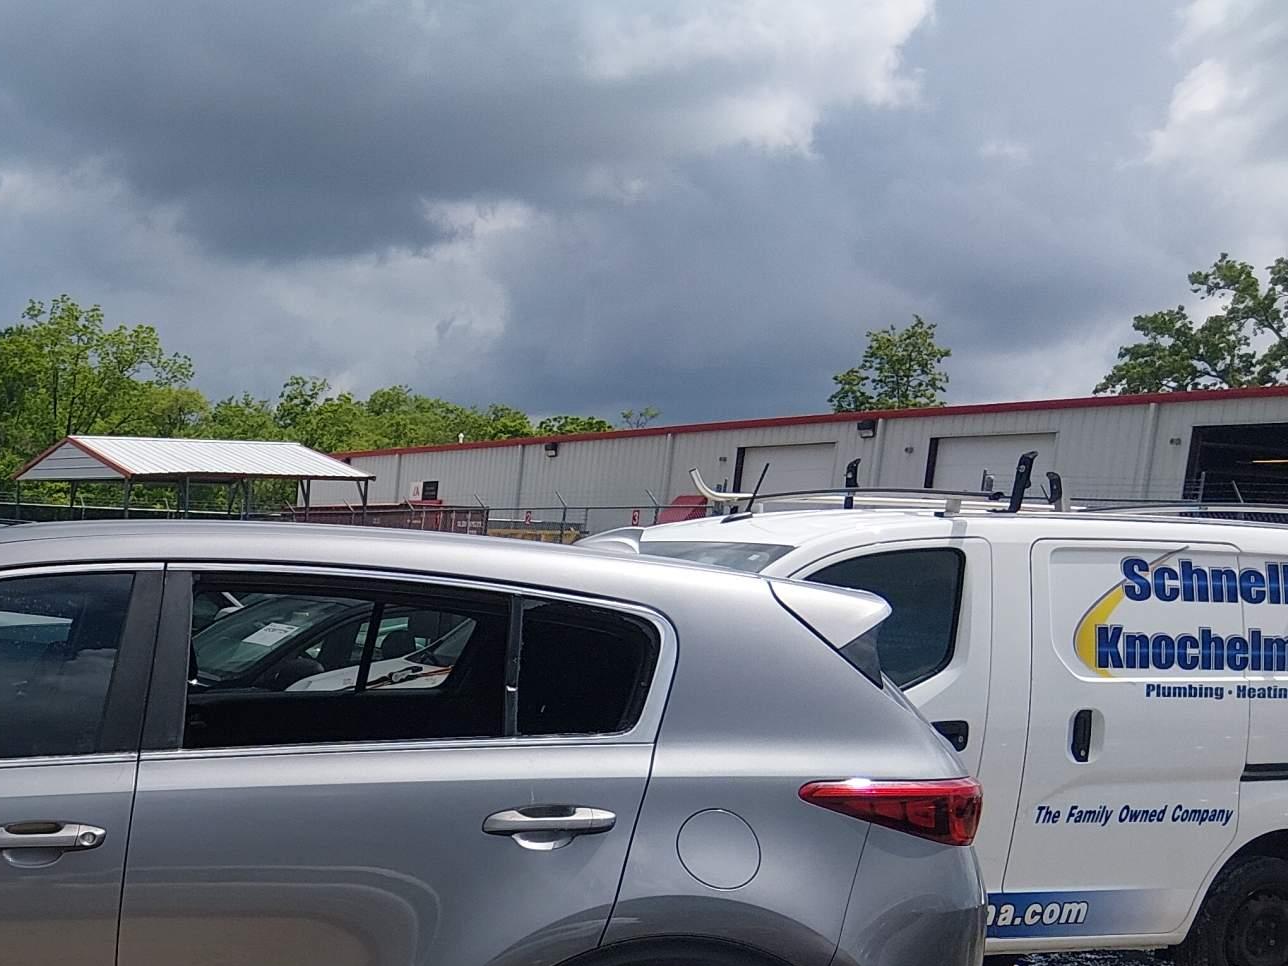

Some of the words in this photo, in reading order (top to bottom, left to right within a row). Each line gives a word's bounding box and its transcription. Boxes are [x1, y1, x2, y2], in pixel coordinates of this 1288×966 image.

[1145, 683, 1224, 700] Plumbing
[1236, 684, 1288, 699] Heatin
[1035, 805, 1061, 824] The
[1065, 805, 1113, 827] Family
[1118, 804, 1168, 823] Owned
[1171, 804, 1234, 826] Company
